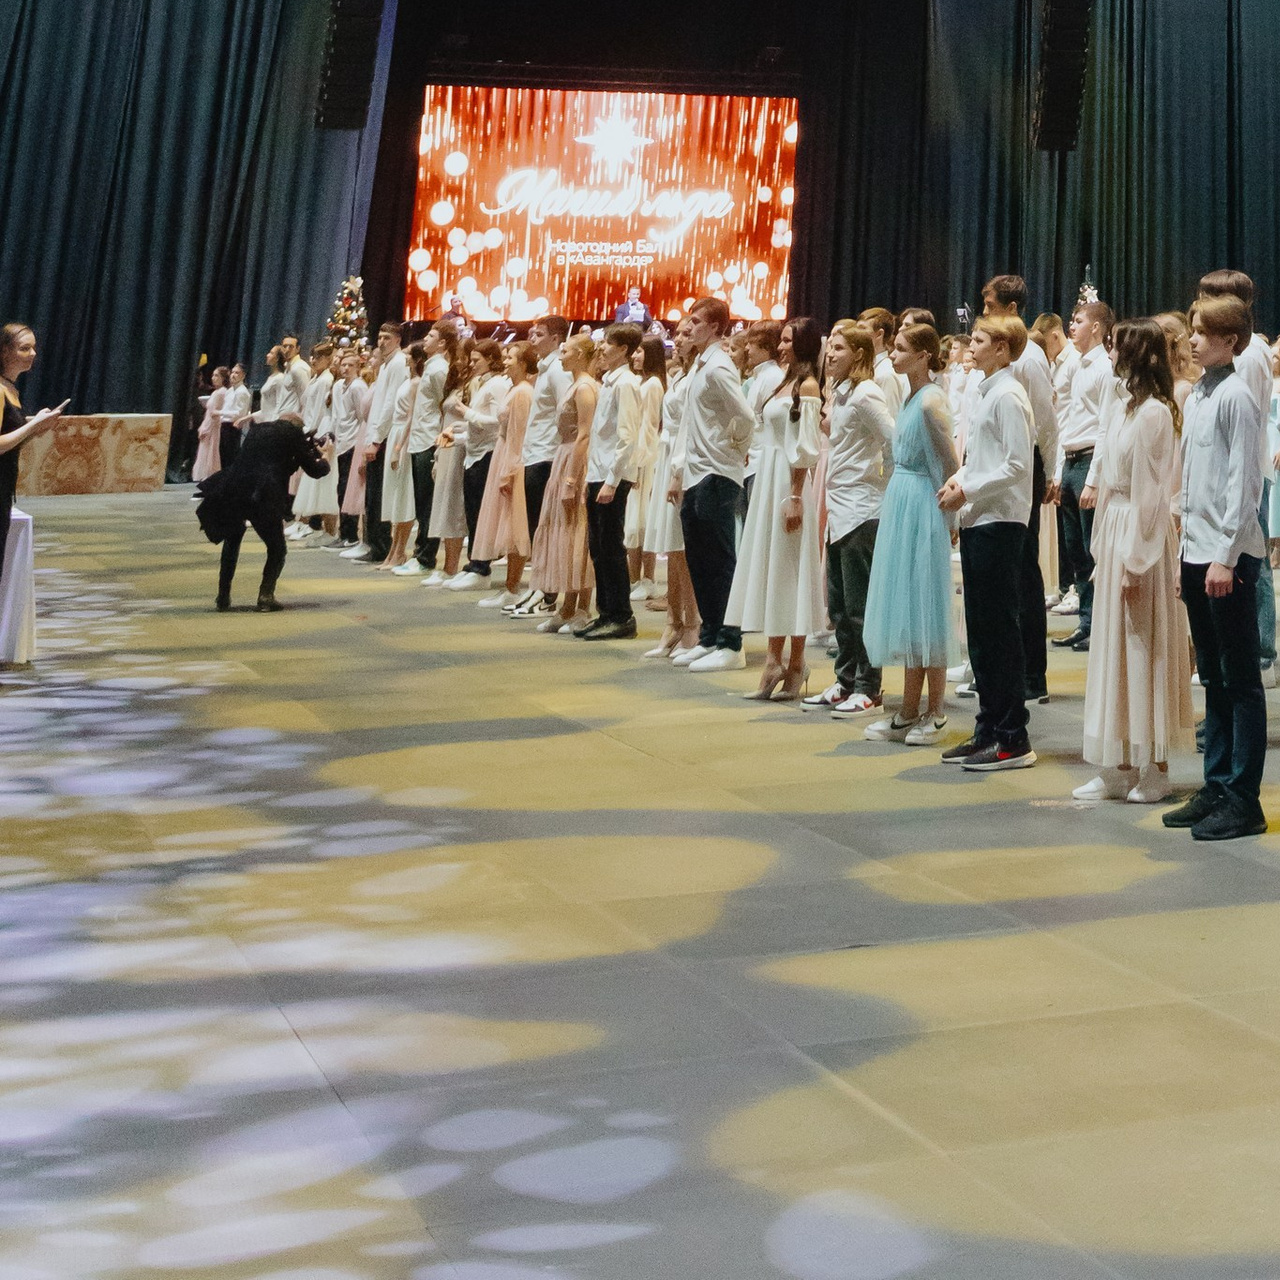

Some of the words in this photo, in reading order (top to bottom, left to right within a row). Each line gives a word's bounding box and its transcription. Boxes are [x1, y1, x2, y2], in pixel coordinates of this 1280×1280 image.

[480, 168, 640, 224] Магия
[640, 188, 735, 243] льда
[549, 239, 633, 254] Новогодний
[556, 255, 565, 266] в
